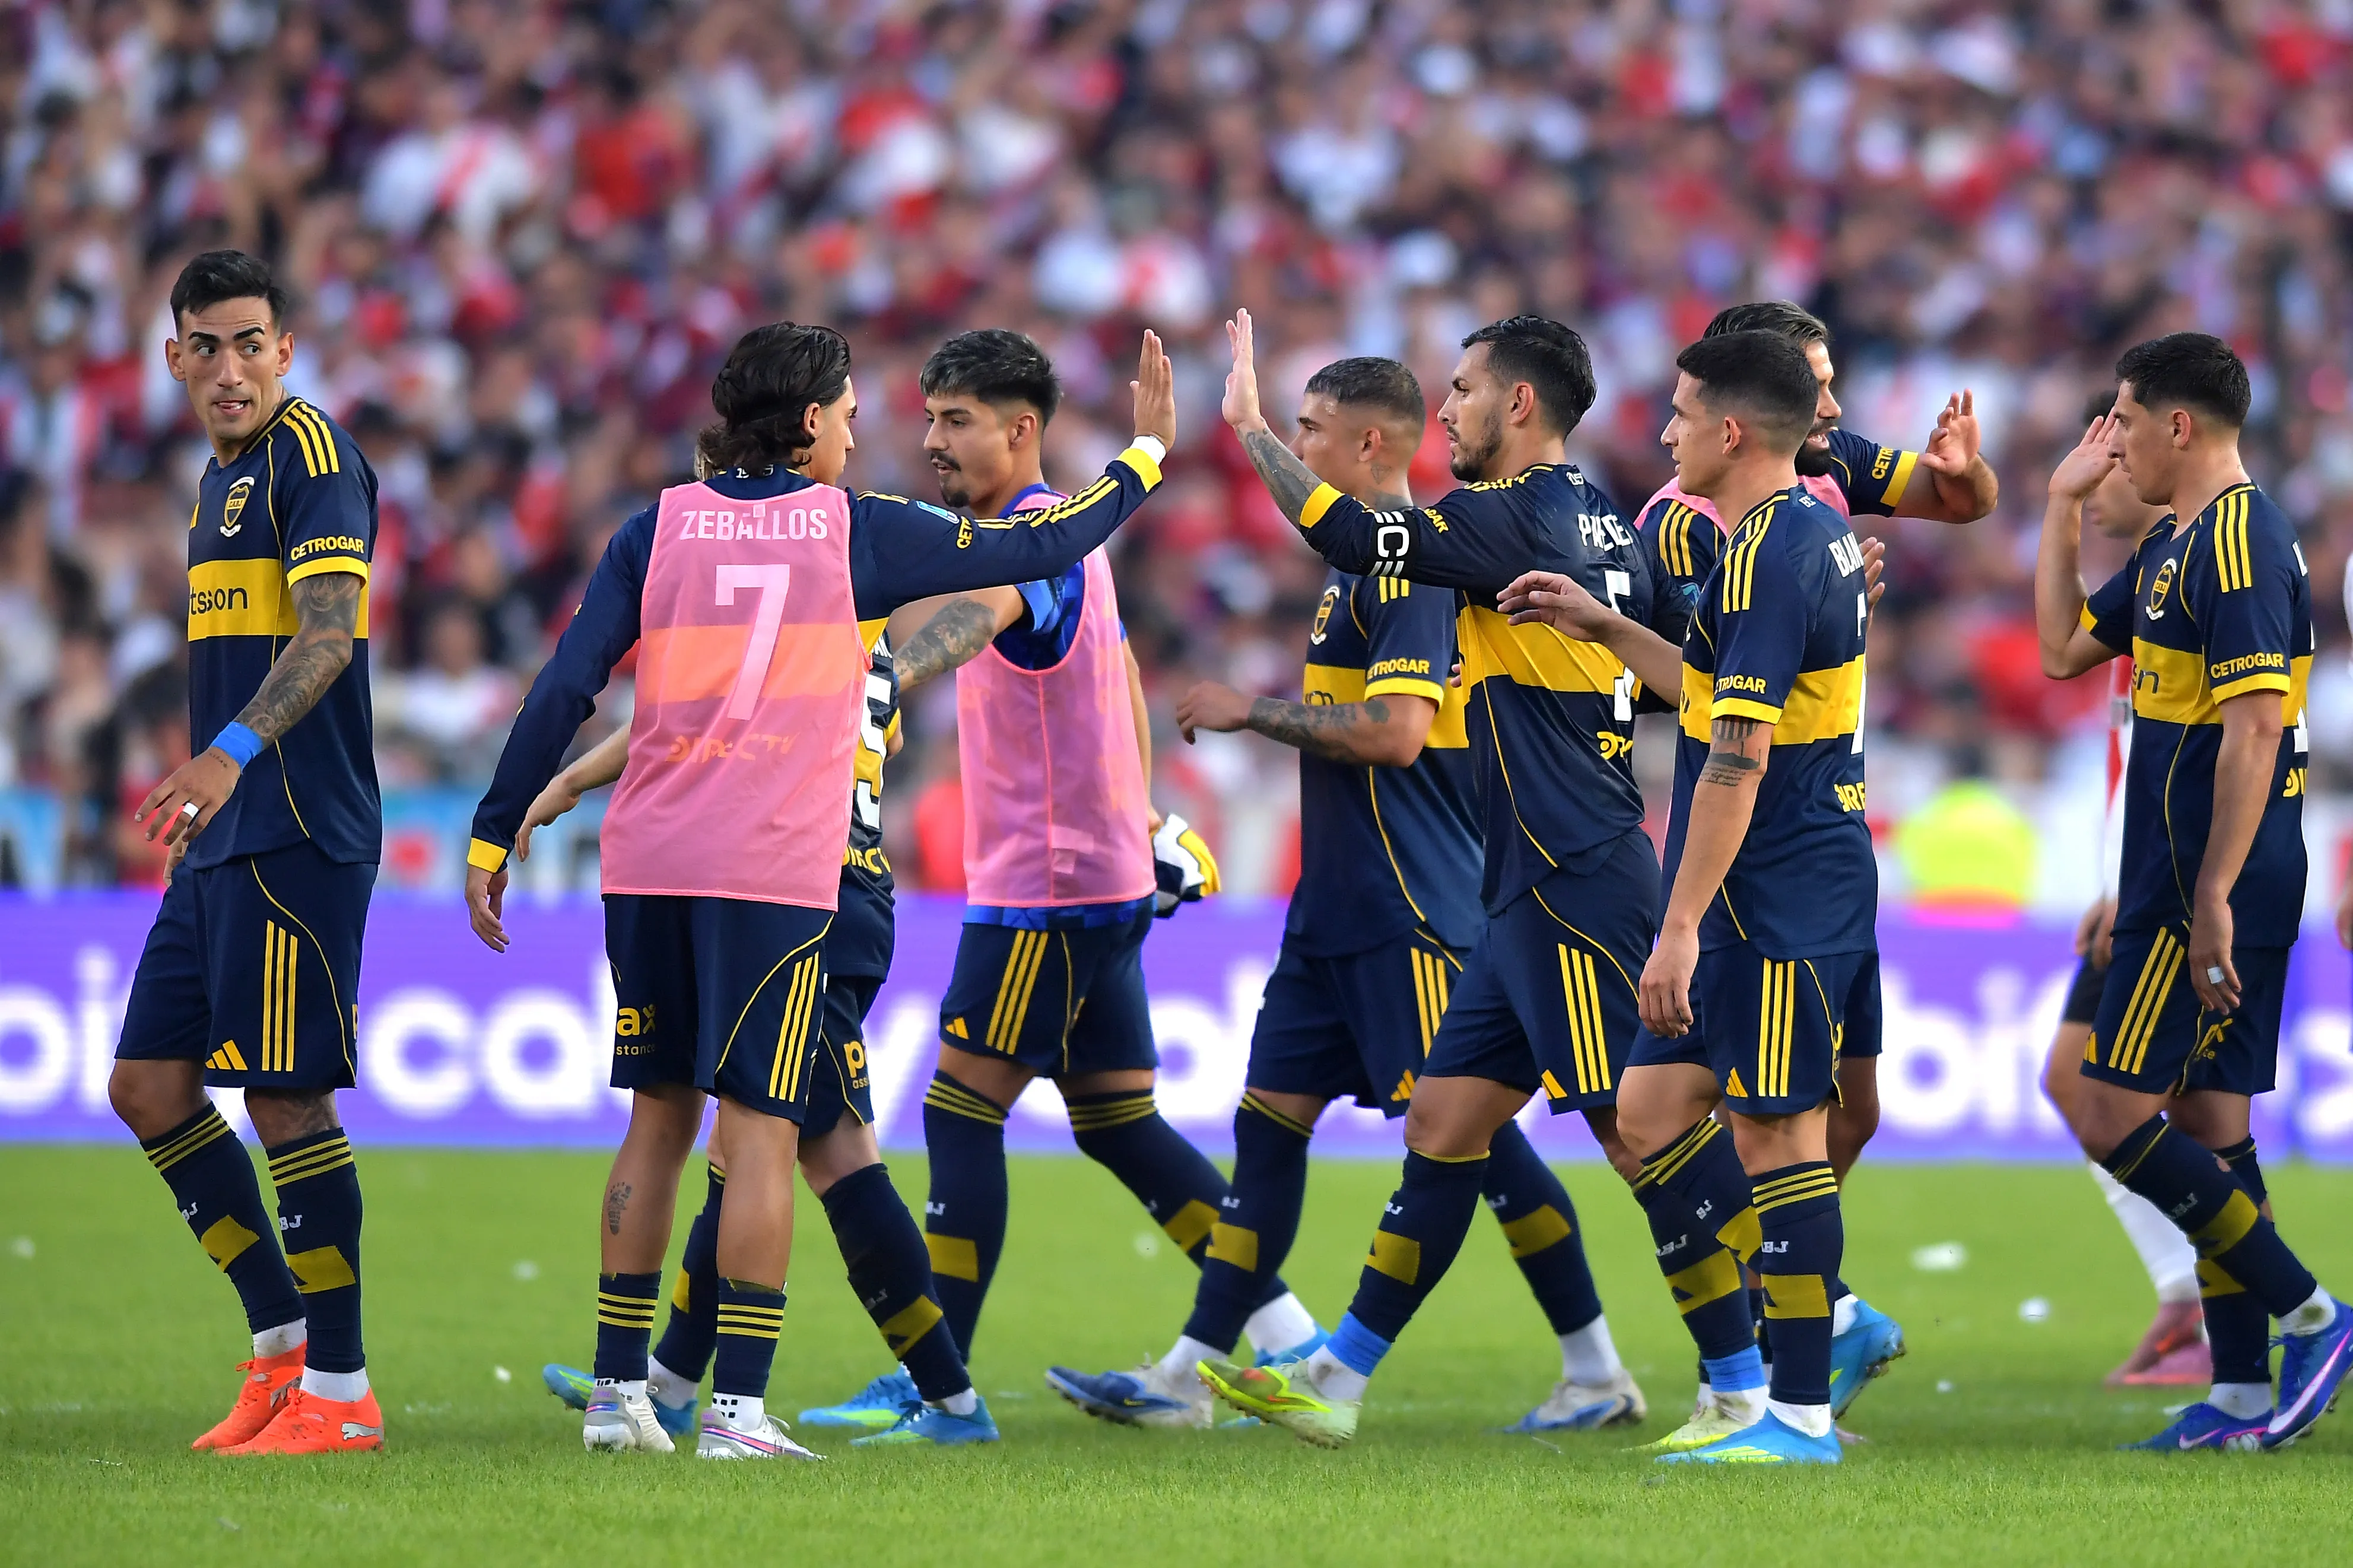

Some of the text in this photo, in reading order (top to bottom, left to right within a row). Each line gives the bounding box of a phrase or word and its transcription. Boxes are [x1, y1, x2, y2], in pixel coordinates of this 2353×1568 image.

[679, 508, 828, 541] ZEBALLOS
[291, 536, 364, 561] CETROGAR
[715, 564, 790, 721] 7
[2211, 653, 2285, 679] CETROGAR
[1761, 1241, 1789, 1253] BJ
